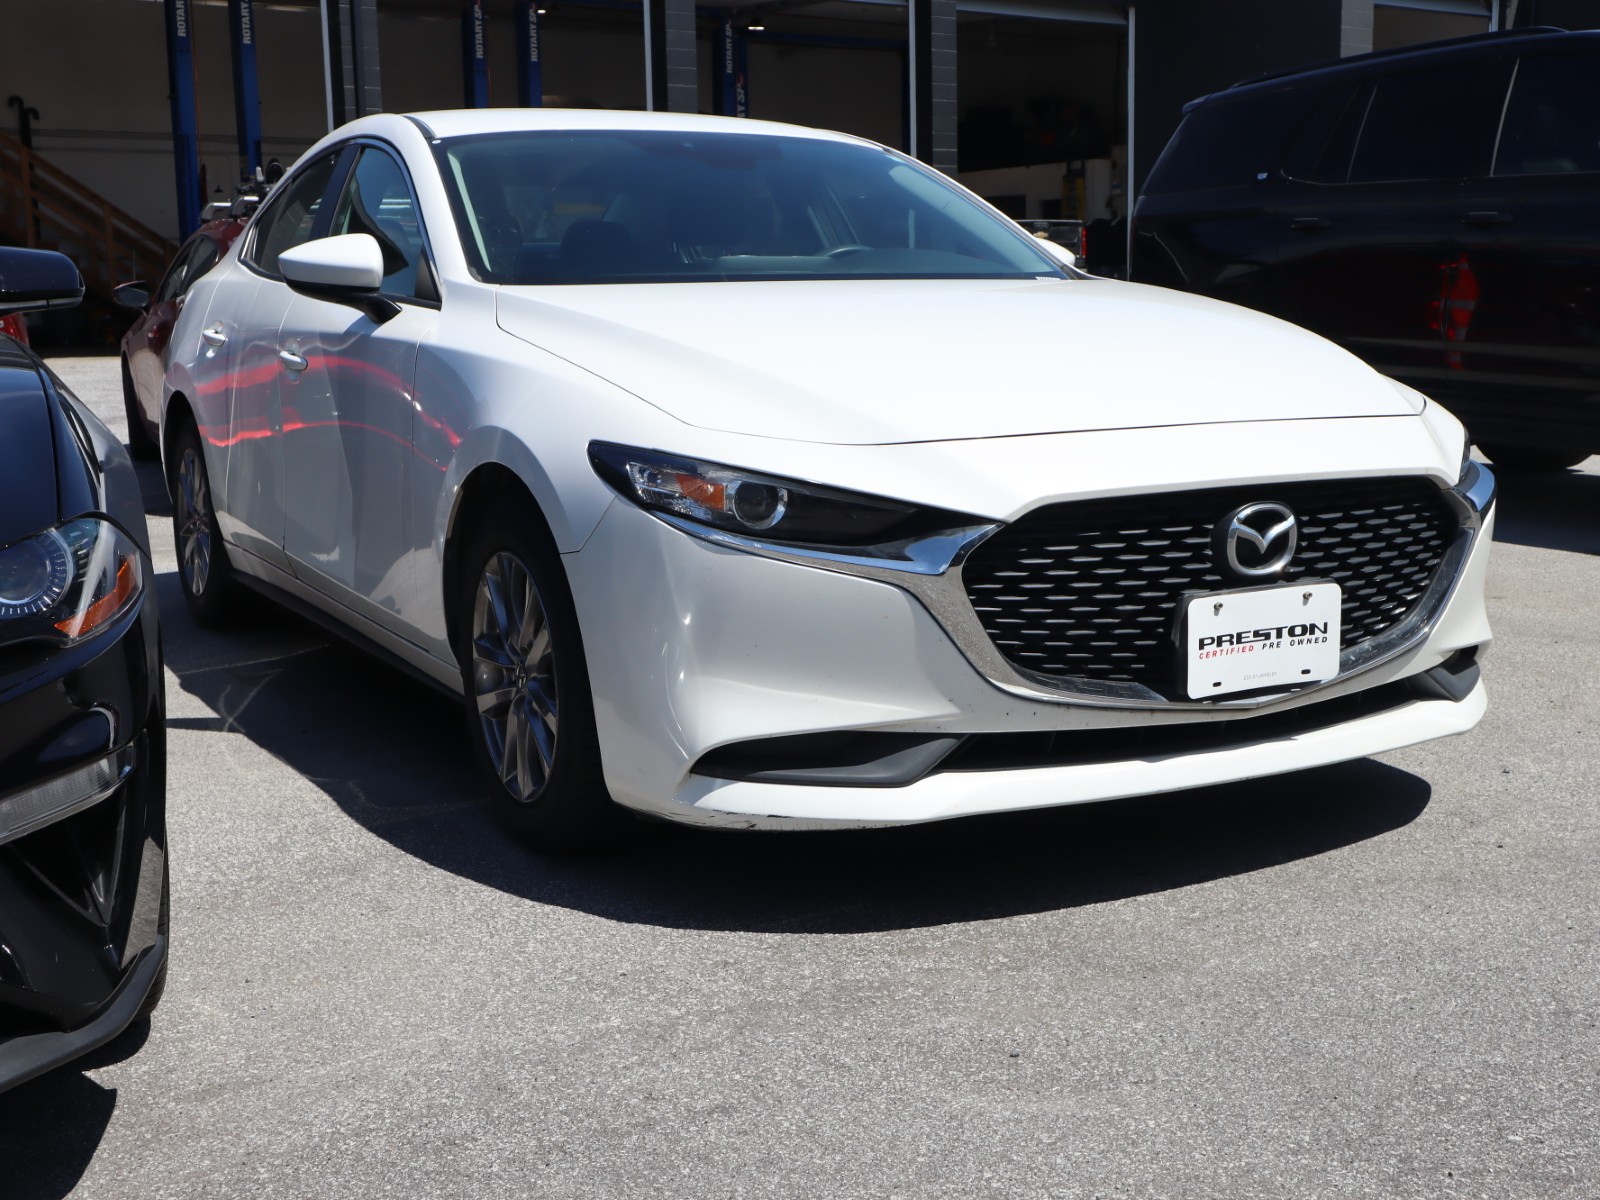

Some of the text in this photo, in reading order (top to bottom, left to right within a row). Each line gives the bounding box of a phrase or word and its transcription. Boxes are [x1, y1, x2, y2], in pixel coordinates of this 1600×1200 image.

[240, 2, 252, 45] ROTARY
[474, 19, 484, 59] ROTARY
[529, 23, 538, 62] ROTARY
[1198, 621, 1328, 651] PRESTON
[1198, 636, 1328, 660] CERTIFIED PRE OWNED
